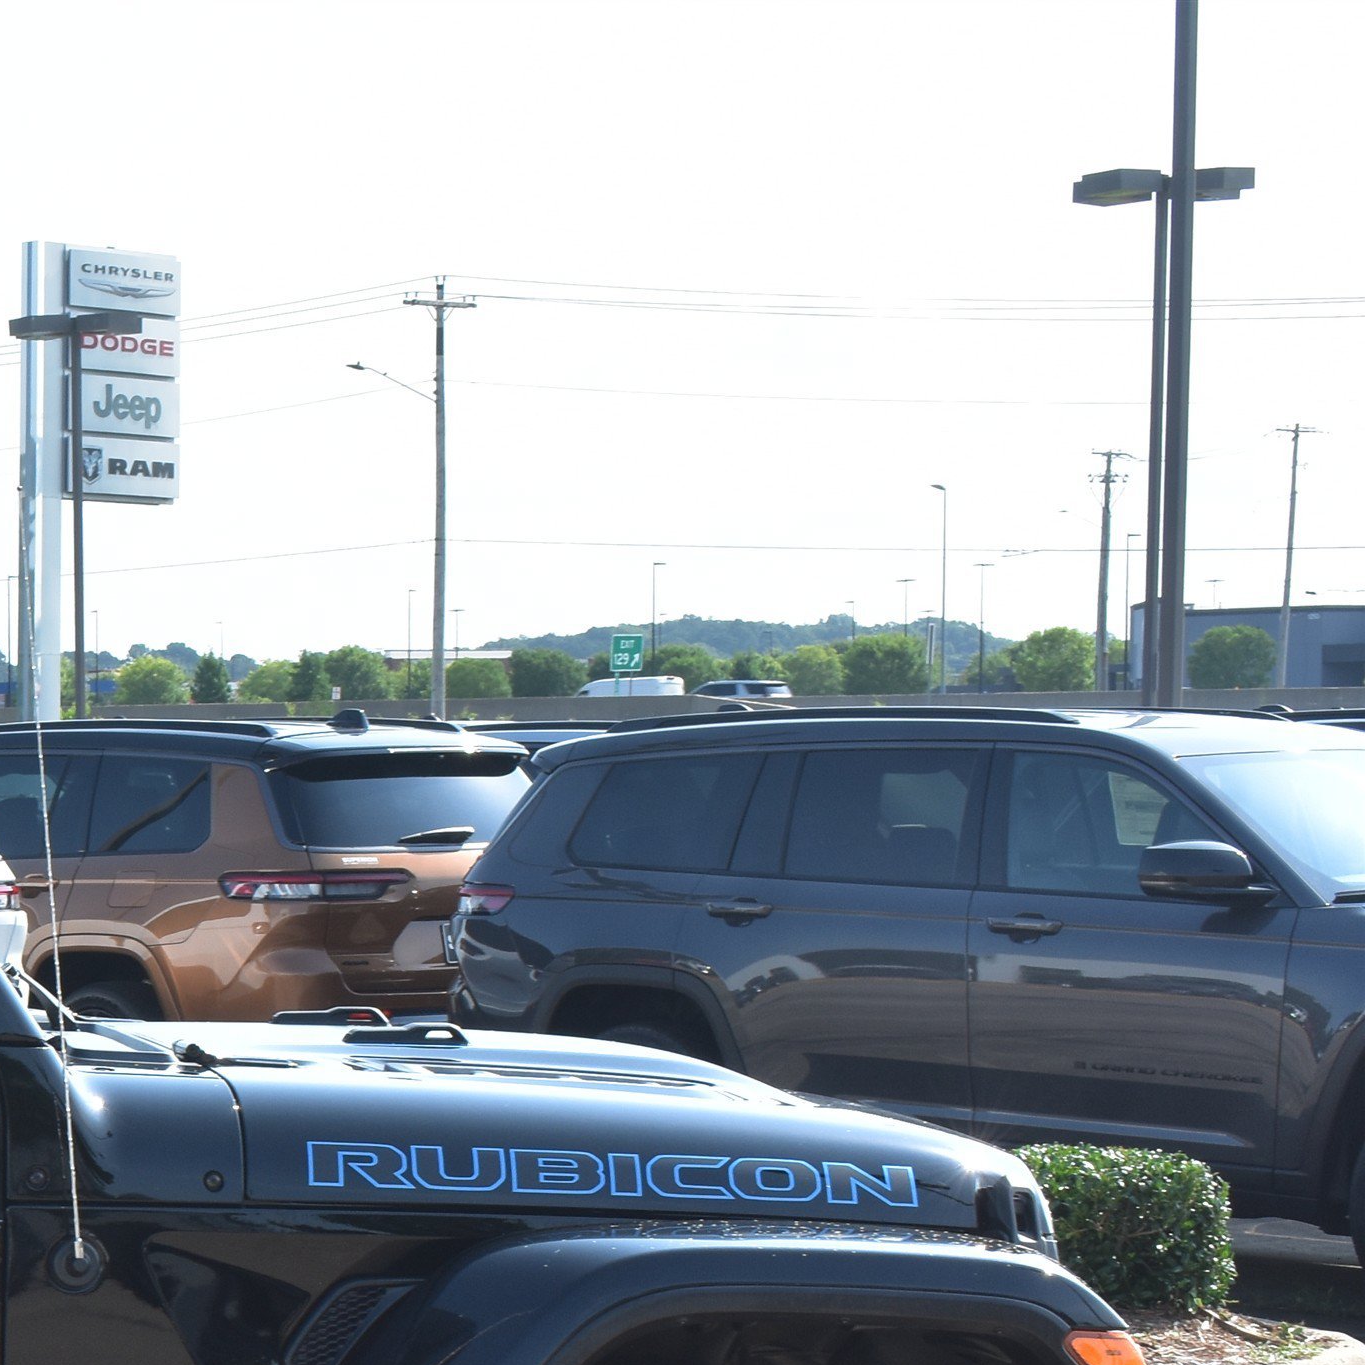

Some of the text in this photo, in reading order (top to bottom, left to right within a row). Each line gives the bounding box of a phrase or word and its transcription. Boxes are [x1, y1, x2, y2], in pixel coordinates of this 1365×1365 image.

[81, 263, 174, 282] CHRYSLER
[81, 332, 174, 357] DODGE
[93, 384, 162, 429] Jeep
[108, 458, 175, 479] RAM
[620, 640, 635, 649] EXIT
[614, 653, 629, 665] 129
[306, 1140, 919, 1207] RUBICON
